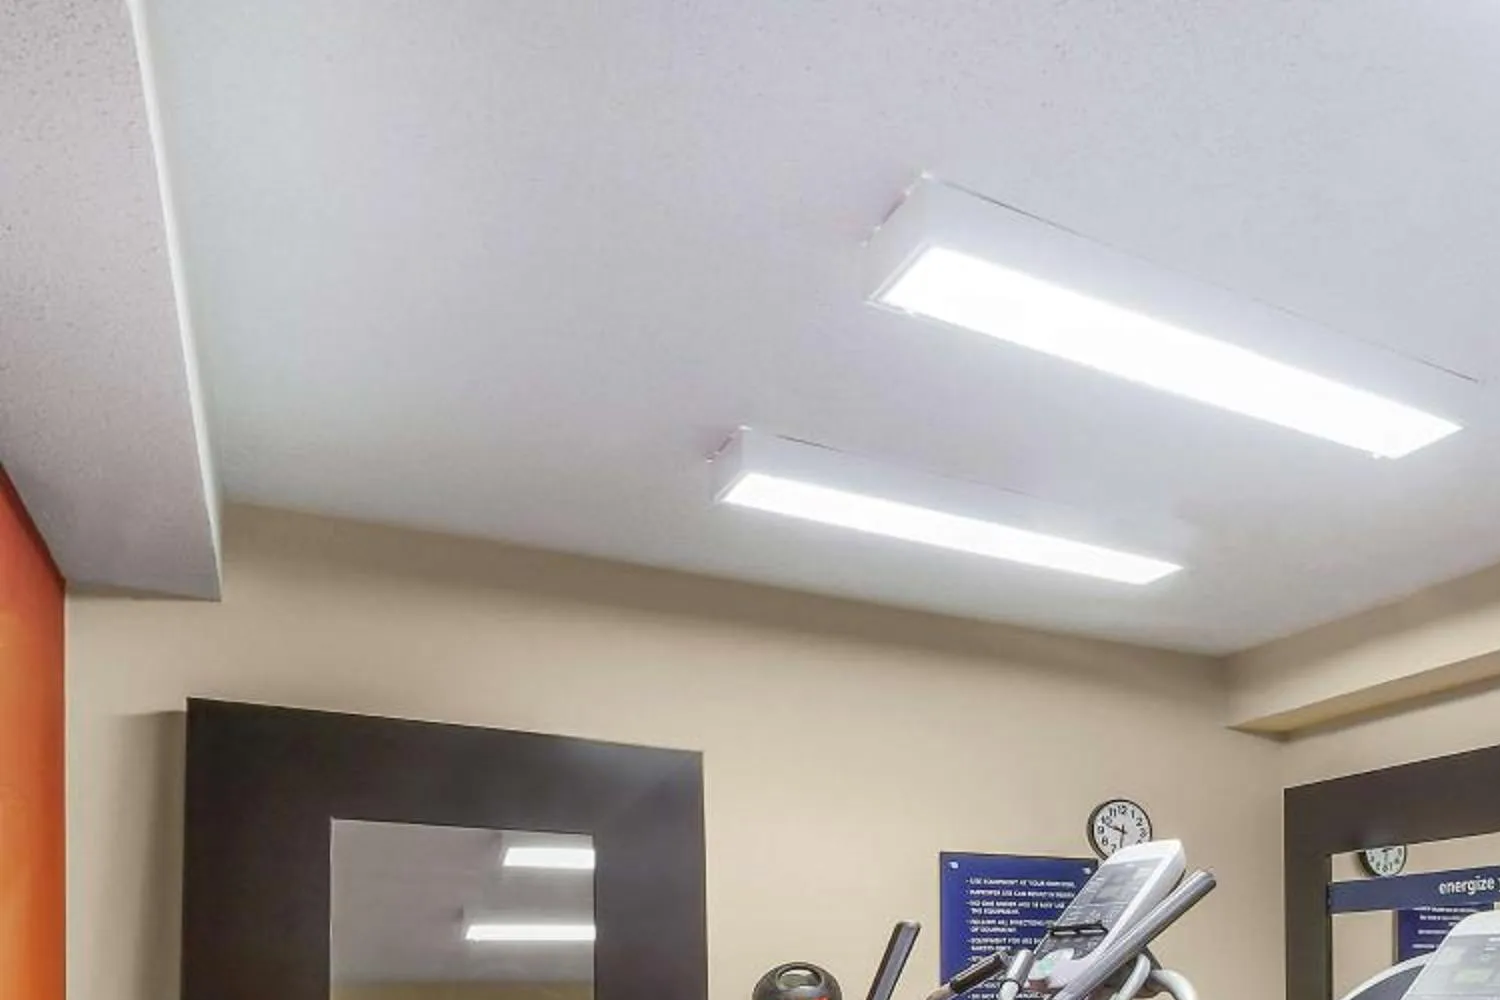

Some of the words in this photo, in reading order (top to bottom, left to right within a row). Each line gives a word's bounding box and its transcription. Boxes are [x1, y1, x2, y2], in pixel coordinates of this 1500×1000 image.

[1108, 807, 1117, 817] 11
[1117, 805, 1128, 815] 12
[1135, 817, 1143, 827] 2
[1097, 825, 1105, 835] 9
[1438, 875, 1496, 896] energize
